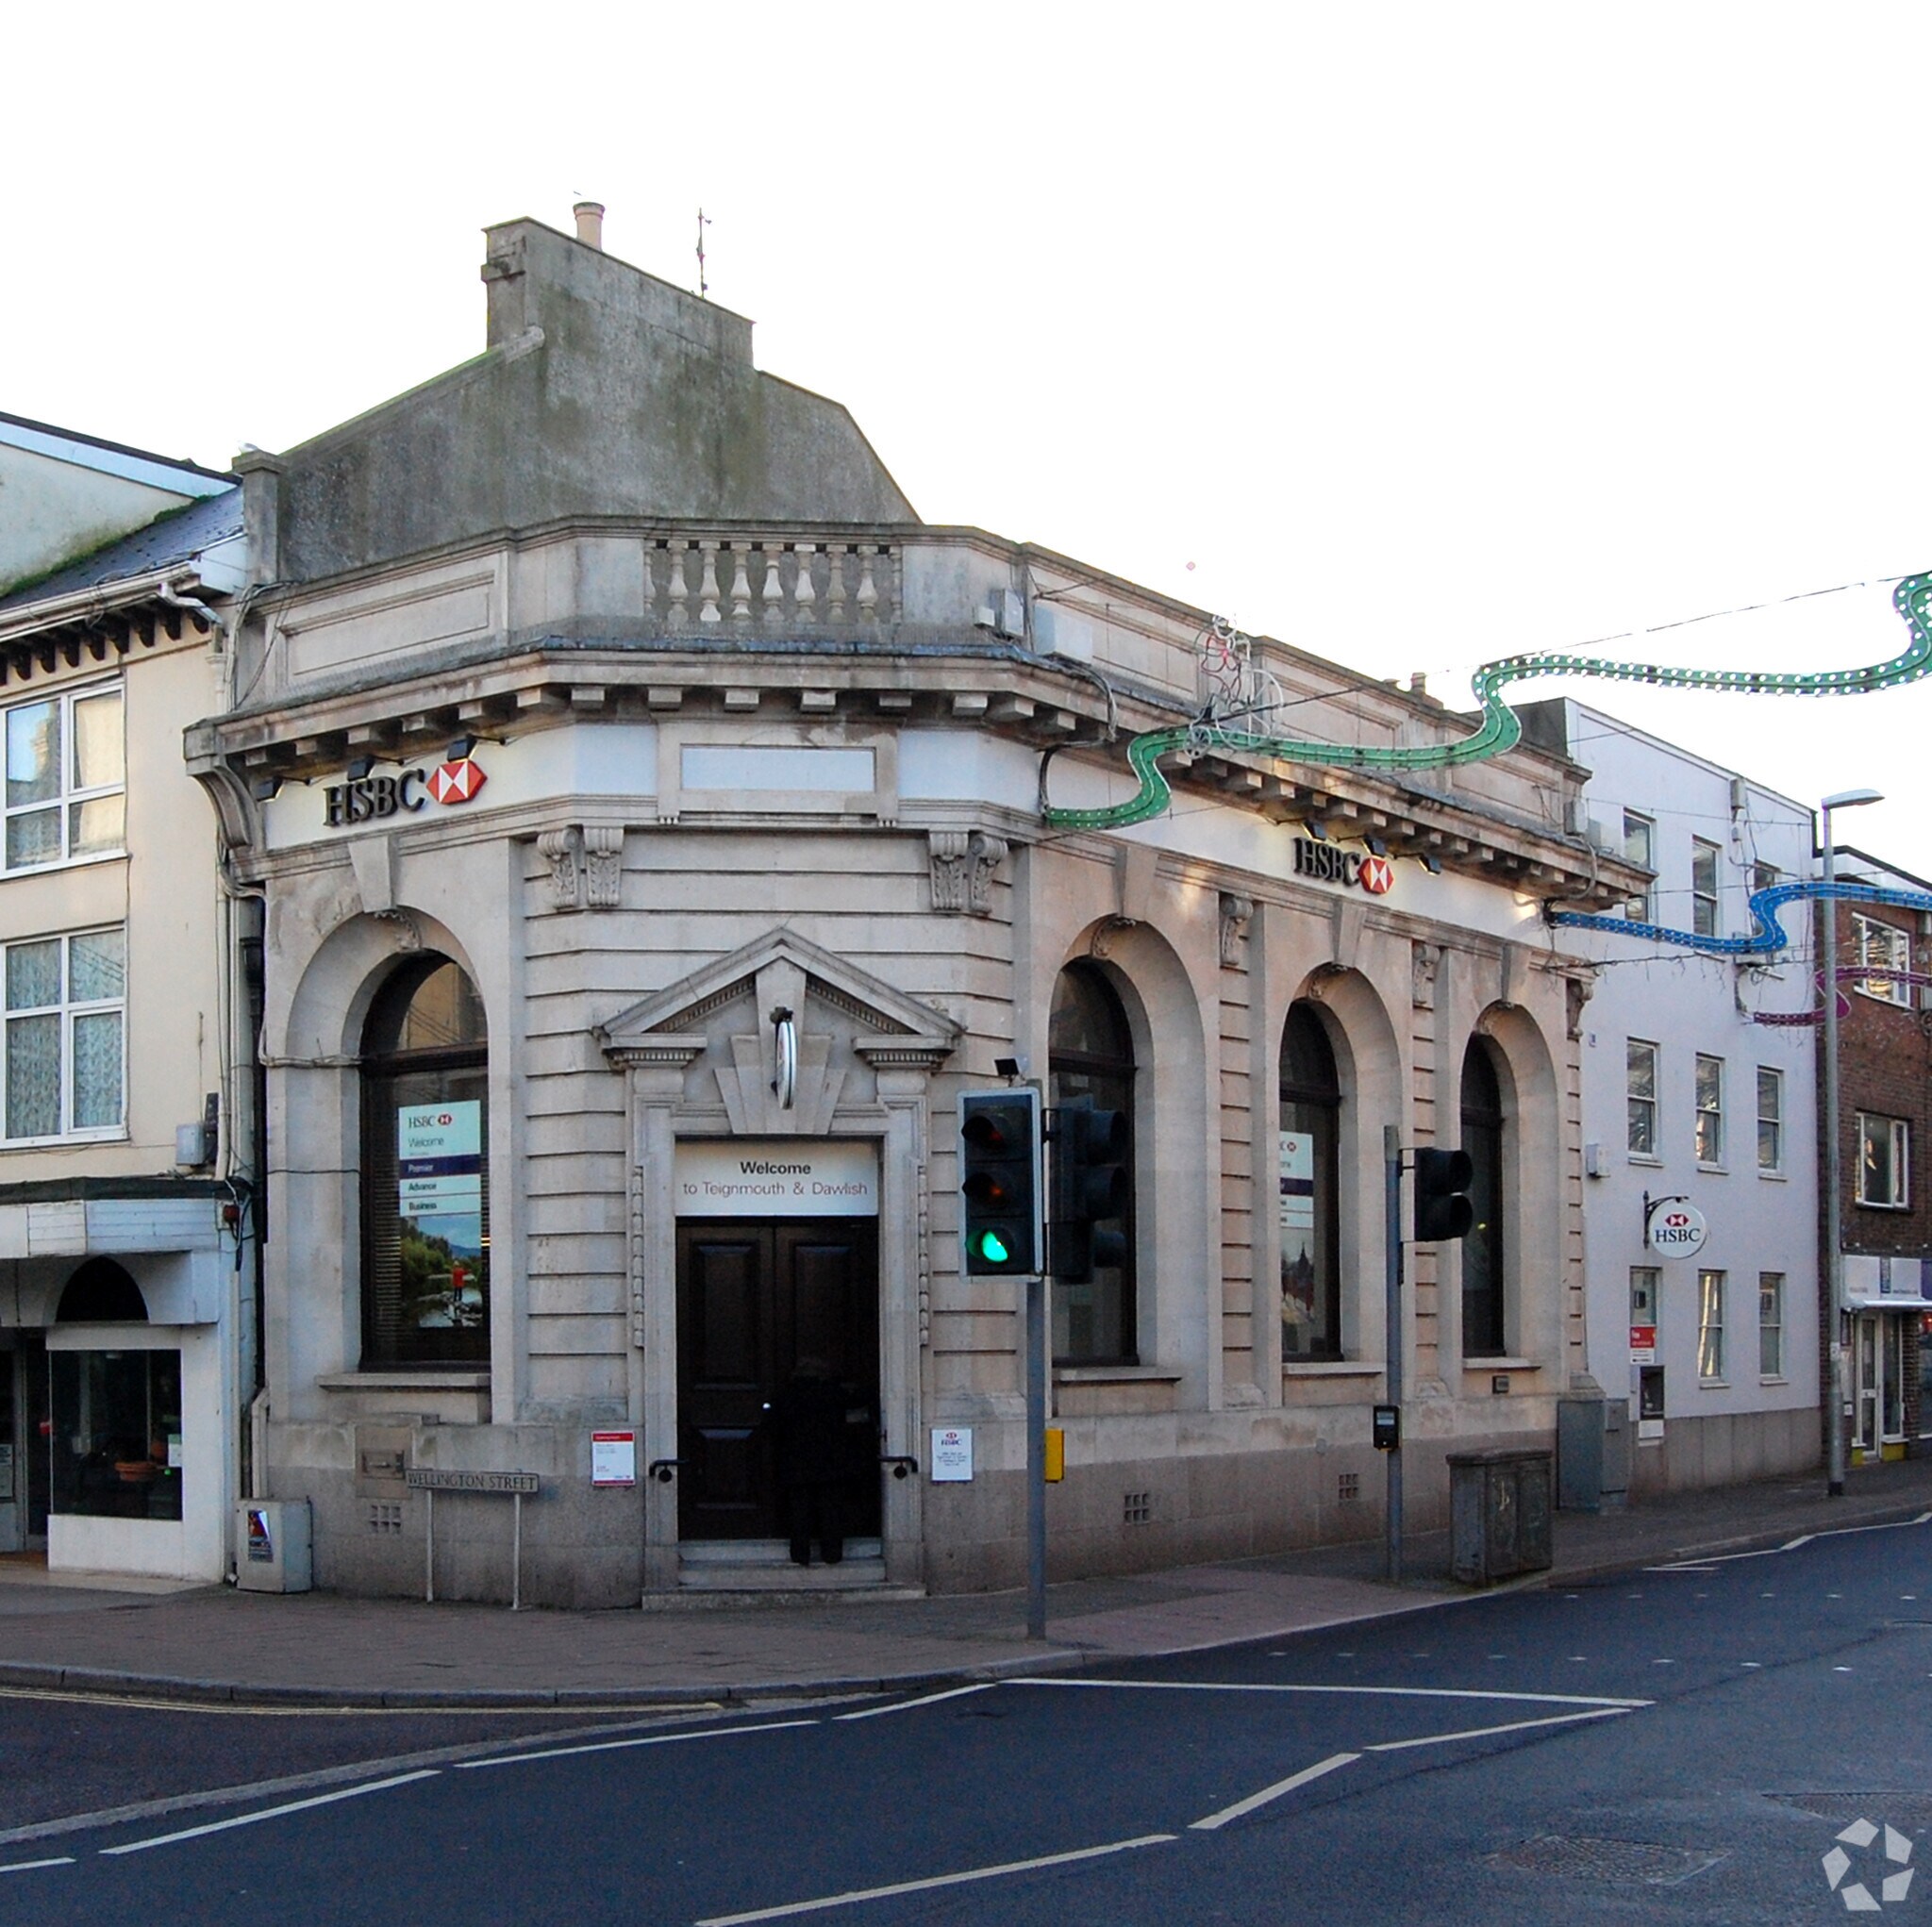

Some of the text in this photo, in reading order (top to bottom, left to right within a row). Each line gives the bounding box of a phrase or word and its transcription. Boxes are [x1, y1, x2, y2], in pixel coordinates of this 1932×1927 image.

[323, 768, 425, 826] HSBC
[1292, 837, 1360, 887] HSBC
[408, 1115, 437, 1129] HSBC
[408, 1137, 444, 1148] Welcome
[740, 1161, 811, 1175] Welcome
[408, 1183, 437, 1191] Advance
[683, 1181, 868, 1198] to Teignmouth & Dawlish
[408, 1202, 438, 1211] Business
[1655, 1228, 1701, 1243] HSBC
[408, 1472, 536, 1490] WELLINGTON STREET
